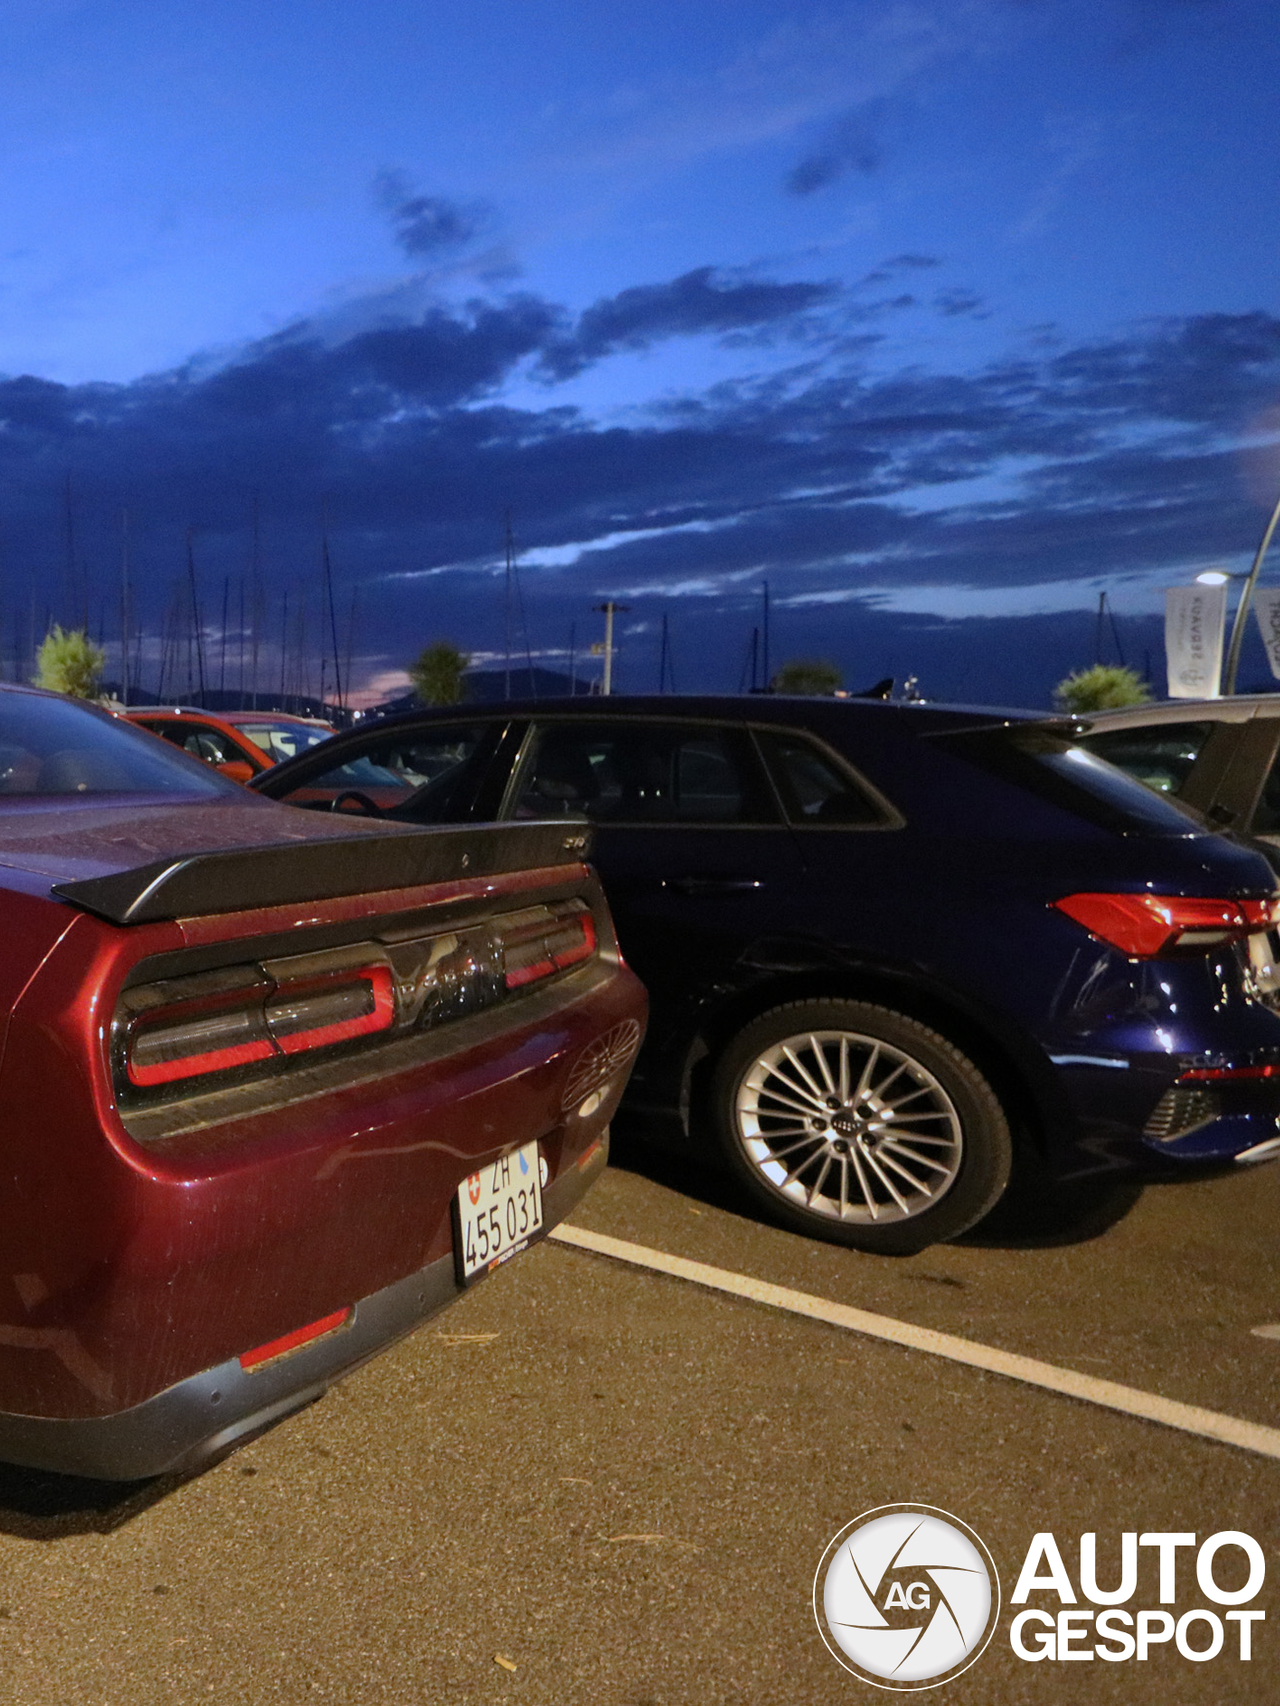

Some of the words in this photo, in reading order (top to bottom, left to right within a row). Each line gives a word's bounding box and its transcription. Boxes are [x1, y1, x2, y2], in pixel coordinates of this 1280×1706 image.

[492, 1156, 510, 1194] ZH
[466, 1204, 502, 1267] 455
[506, 1182, 539, 1241] 031
